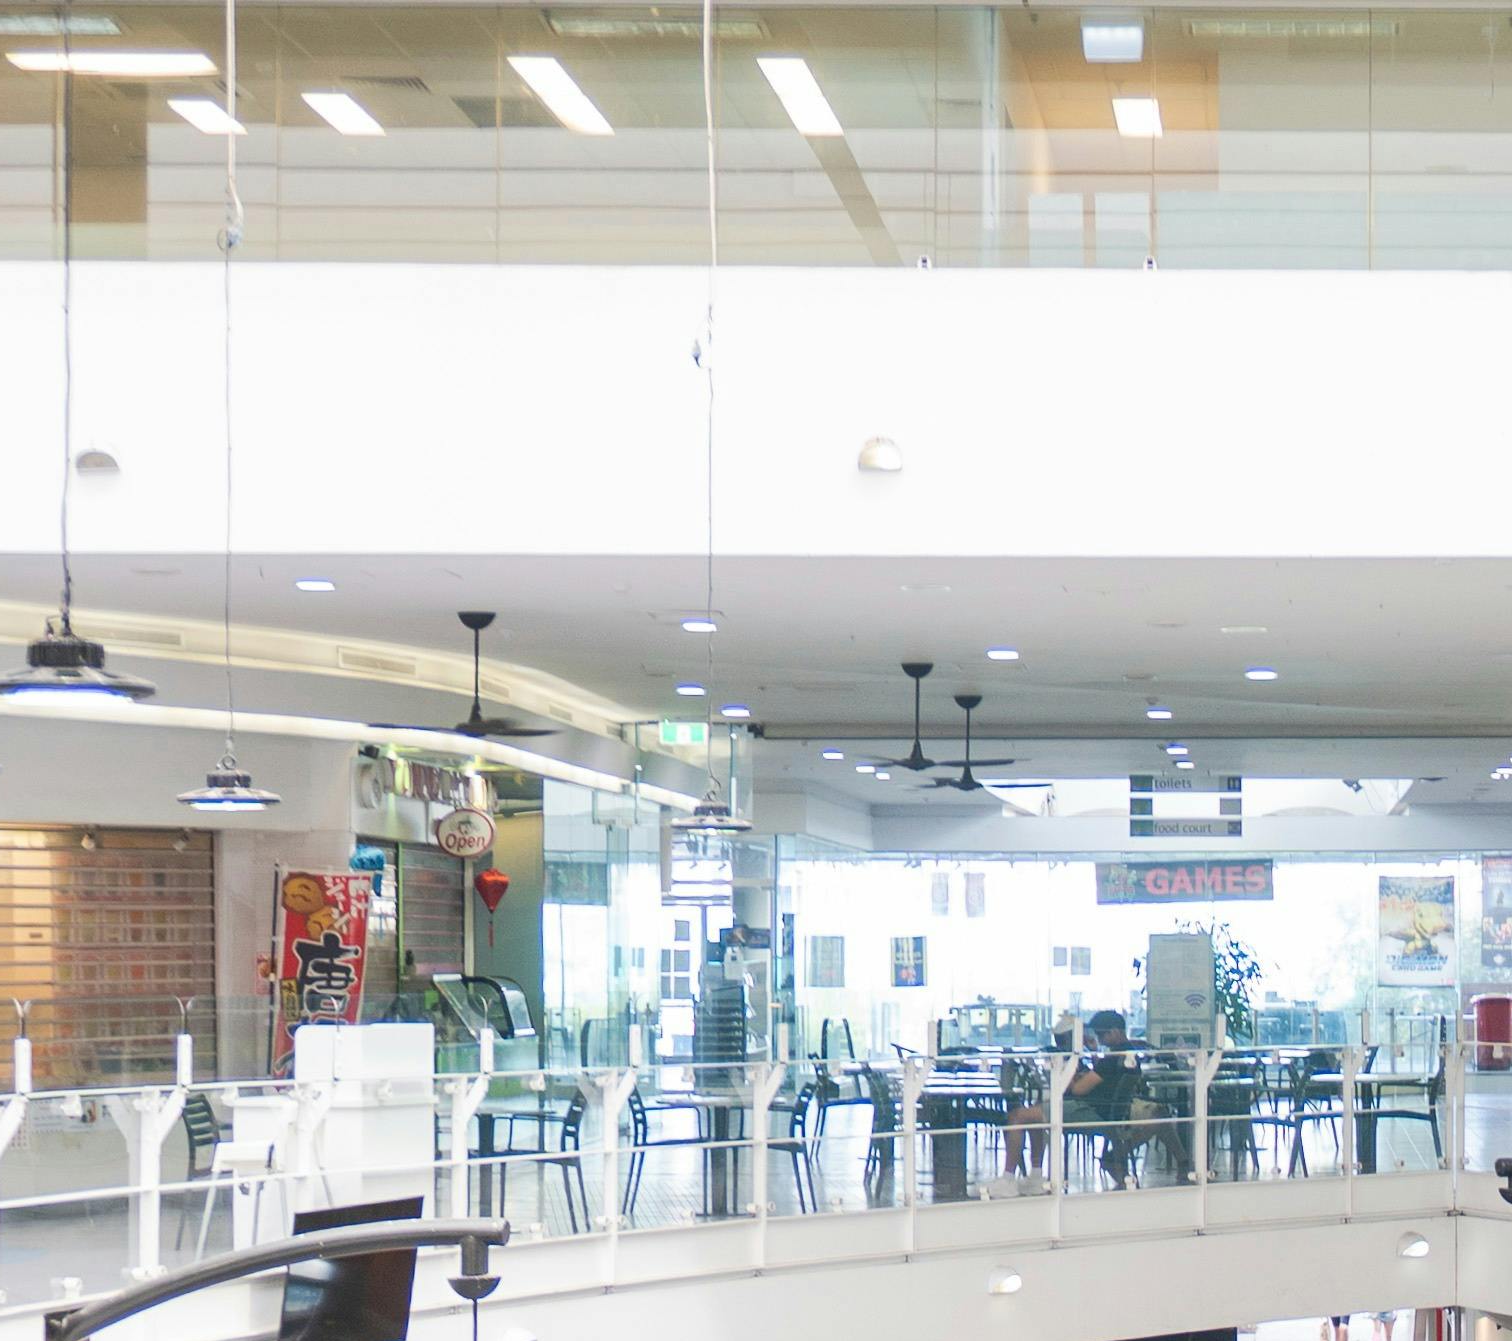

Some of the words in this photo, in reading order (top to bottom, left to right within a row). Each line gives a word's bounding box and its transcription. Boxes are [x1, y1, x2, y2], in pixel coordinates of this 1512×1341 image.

[1154, 775, 1192, 790] toilets
[1154, 823, 1179, 834] food
[1182, 824, 1213, 834] court
[445, 833, 486, 853] Open
[1144, 864, 1267, 896] GAMES
